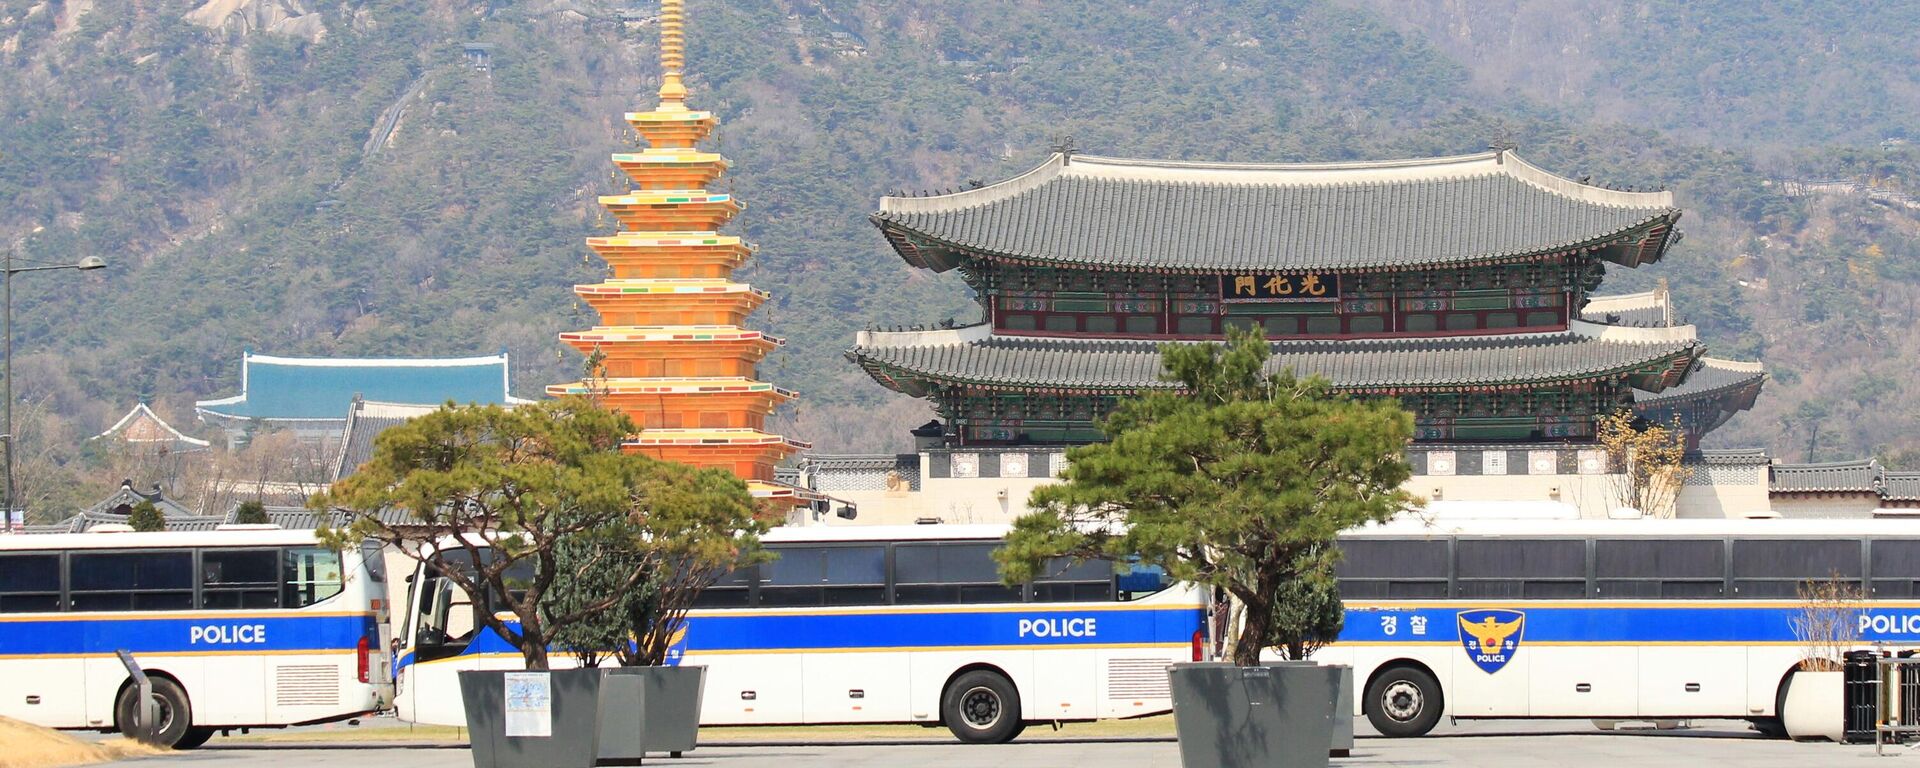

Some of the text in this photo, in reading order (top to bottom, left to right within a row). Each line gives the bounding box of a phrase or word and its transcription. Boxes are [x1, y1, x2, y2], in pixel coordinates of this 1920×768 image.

[190, 624, 266, 644] POLICE
[1019, 618, 1097, 638] POLICE
[1476, 655, 1506, 663] POLICE
